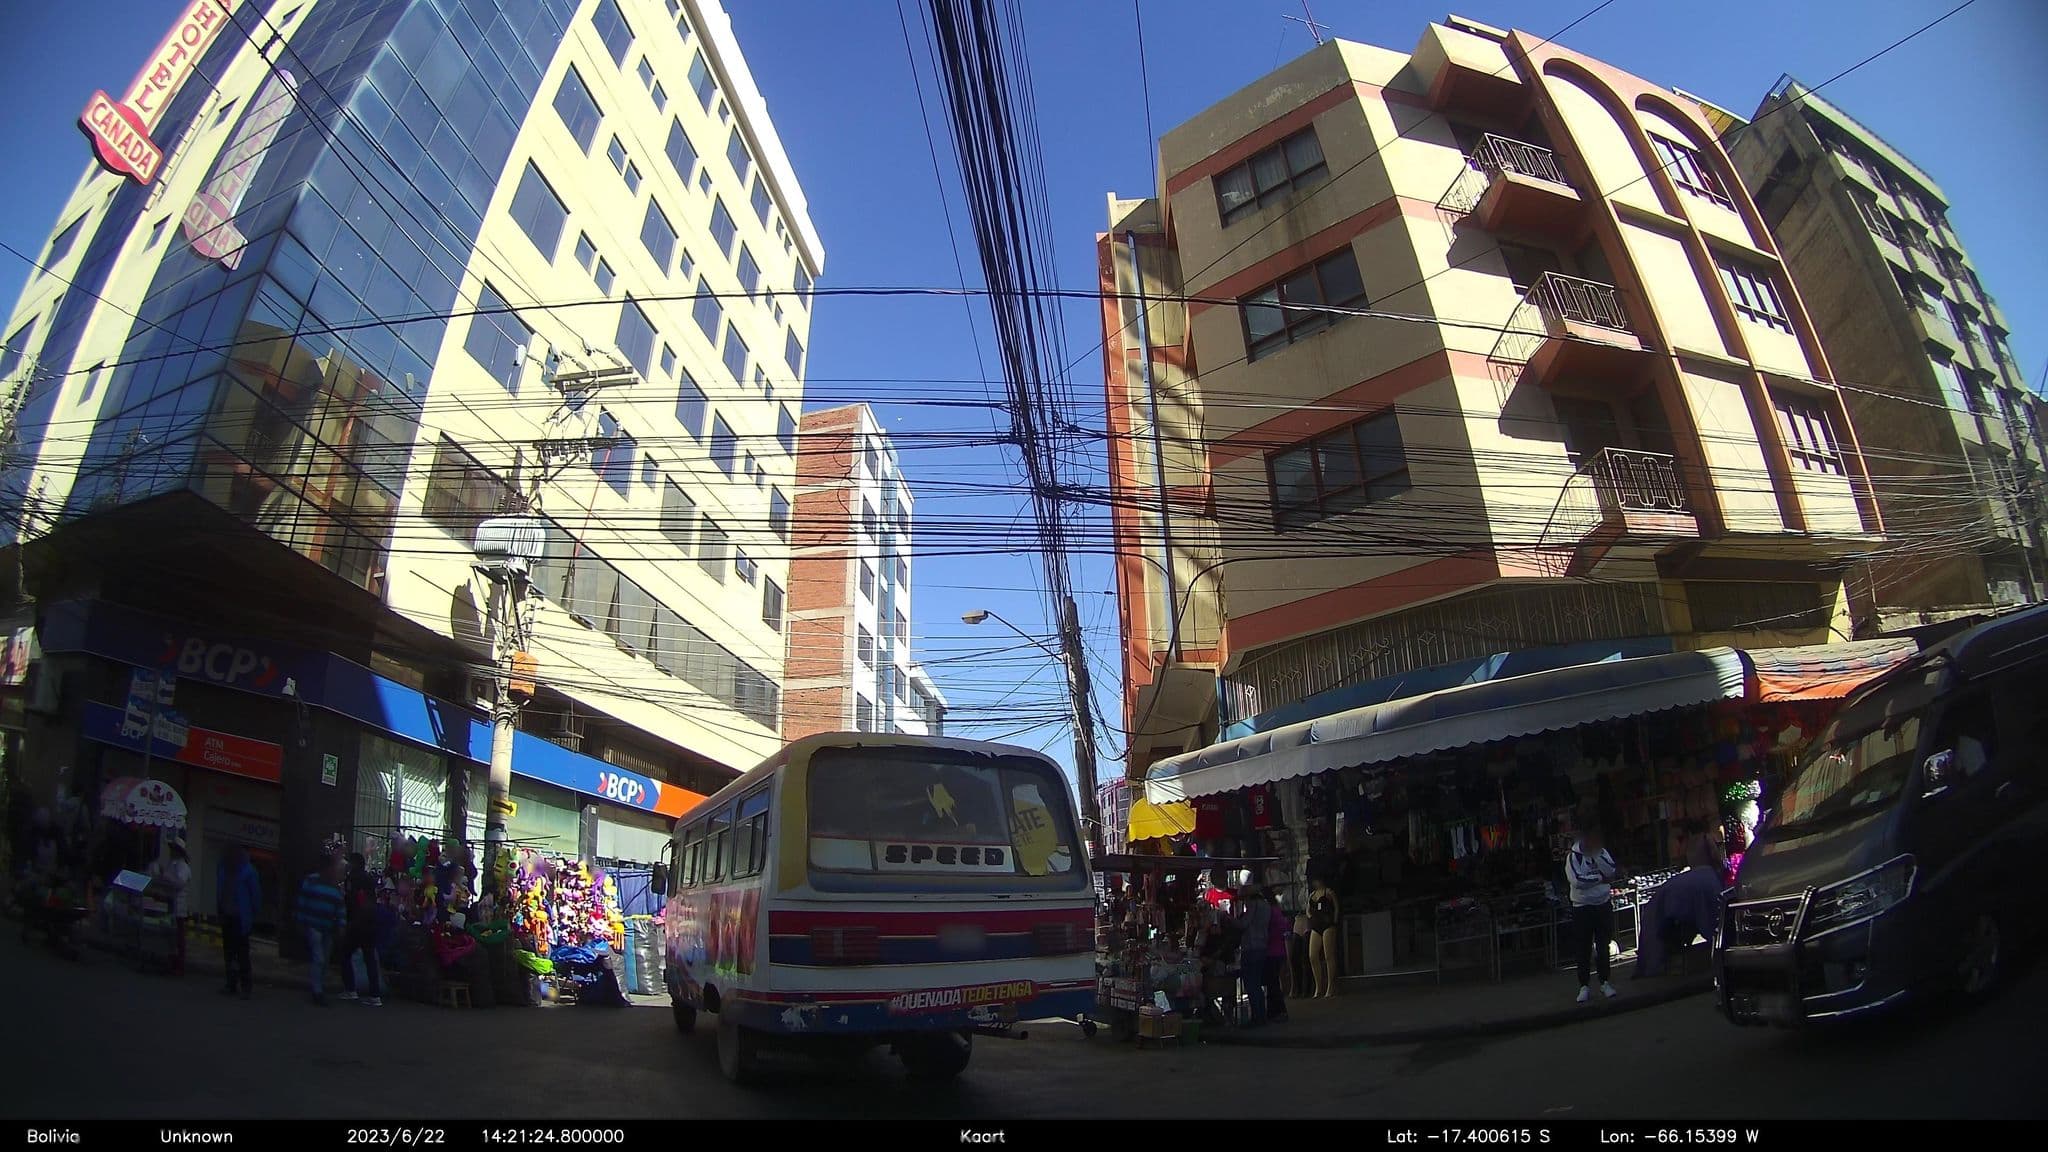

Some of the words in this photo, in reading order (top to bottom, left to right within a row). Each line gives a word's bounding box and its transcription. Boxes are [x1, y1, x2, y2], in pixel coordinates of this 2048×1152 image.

[135, 2, 218, 113] HOTEL
[91, 102, 154, 175] CANADA
[176, 637, 257, 683] BCP
[204, 736, 224, 750] ATM
[606, 772, 638, 802] BCP
[886, 845, 1005, 866] SPEED
